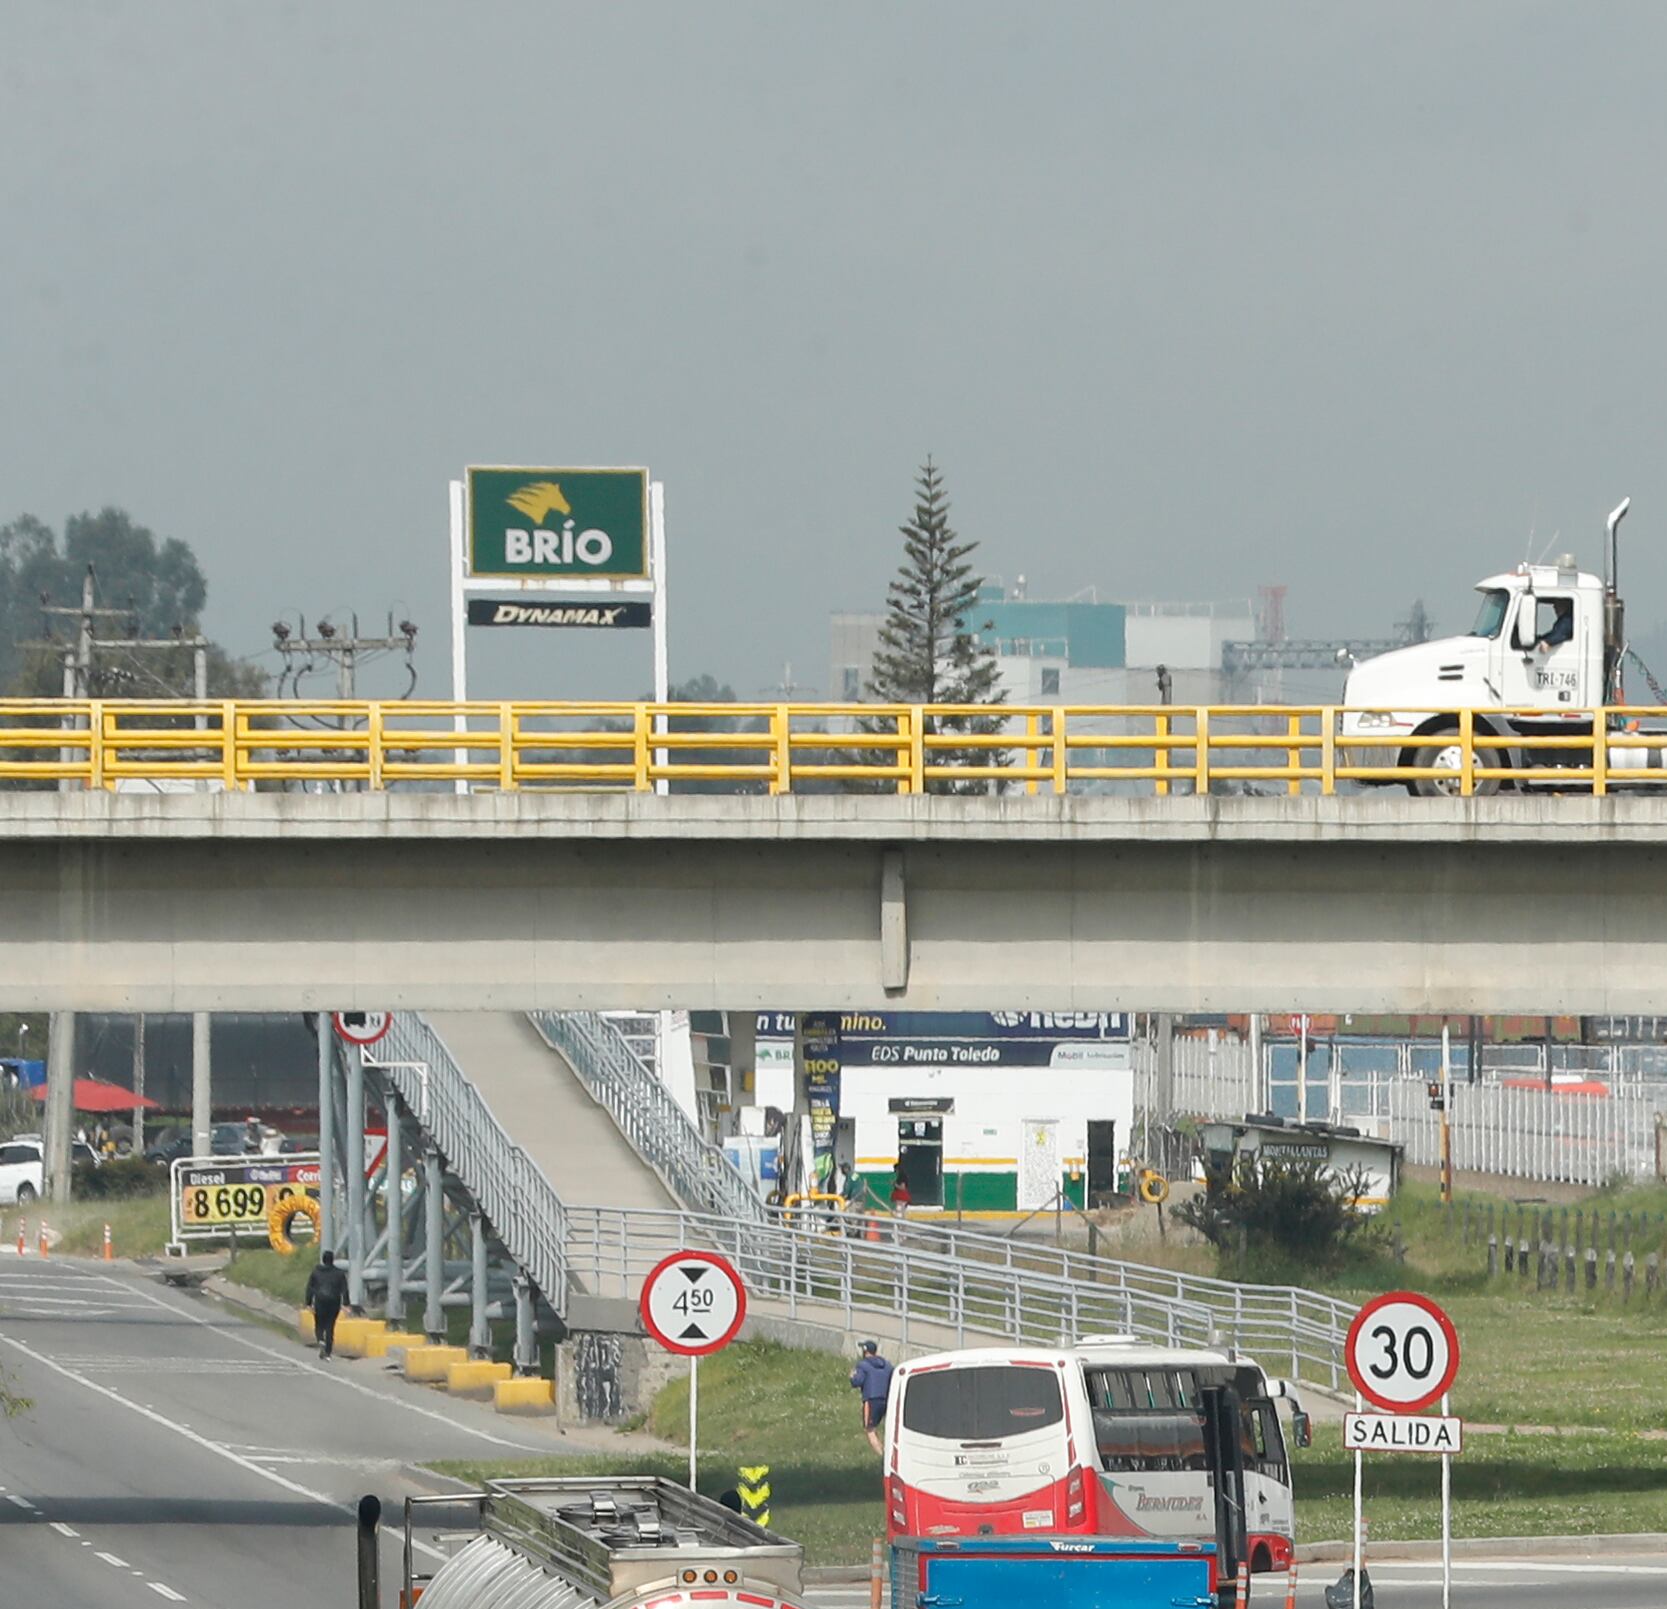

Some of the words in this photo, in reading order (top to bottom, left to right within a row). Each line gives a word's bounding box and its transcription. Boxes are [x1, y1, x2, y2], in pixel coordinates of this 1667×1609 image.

[505, 519, 612, 565] BRÍO
[493, 605, 621, 625] DYNAMAX
[775, 1051, 794, 1060] BR
[871, 1045, 900, 1062] EDS
[903, 1046, 948, 1062] Punto
[951, 1045, 1000, 1062] Toledo
[190, 1172, 225, 1185] Diesel
[1369, 1325, 1434, 1380] 30
[1353, 1419, 1452, 1447] SALIDA
